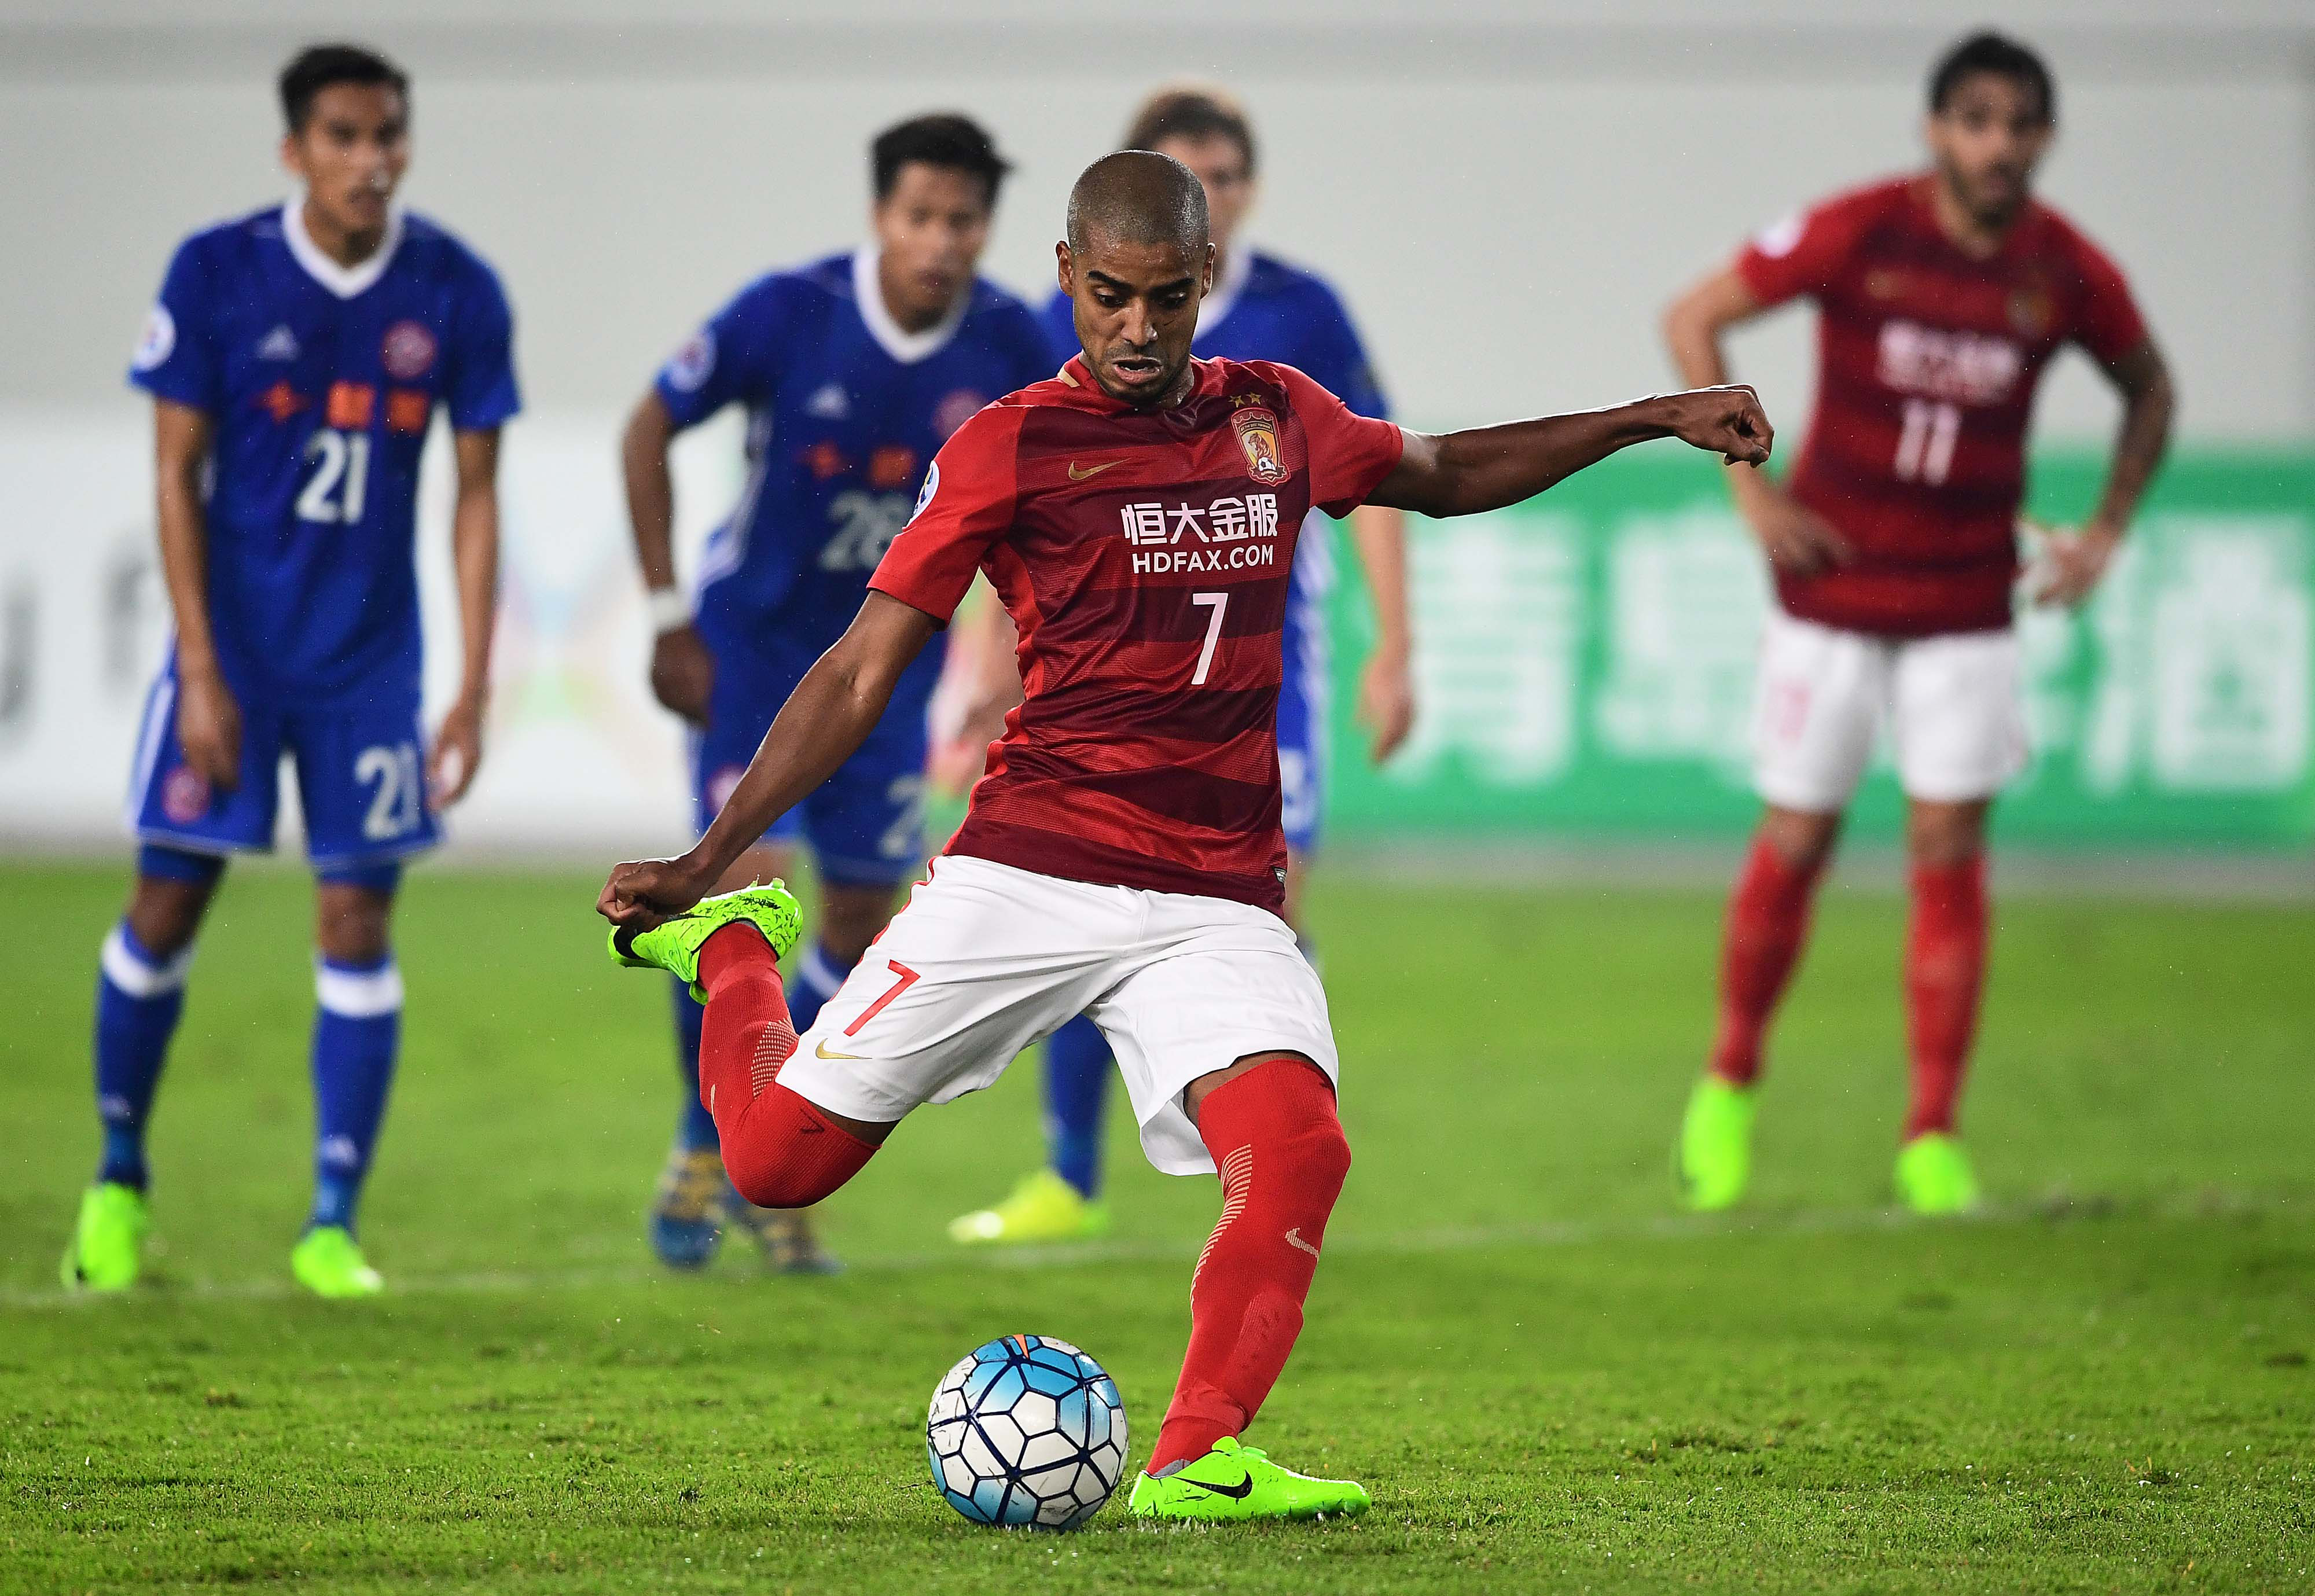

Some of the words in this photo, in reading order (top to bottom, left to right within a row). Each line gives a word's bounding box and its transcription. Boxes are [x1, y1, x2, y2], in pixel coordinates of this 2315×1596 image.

[296, 428, 369, 524] 21
[1892, 397, 1962, 487] 11
[1120, 494, 1278, 545] 恒大金服
[1132, 545, 1274, 573] HDFAX.COM
[1191, 593, 1229, 685] 7
[355, 742, 421, 840] 21
[843, 959, 921, 1037] 7
